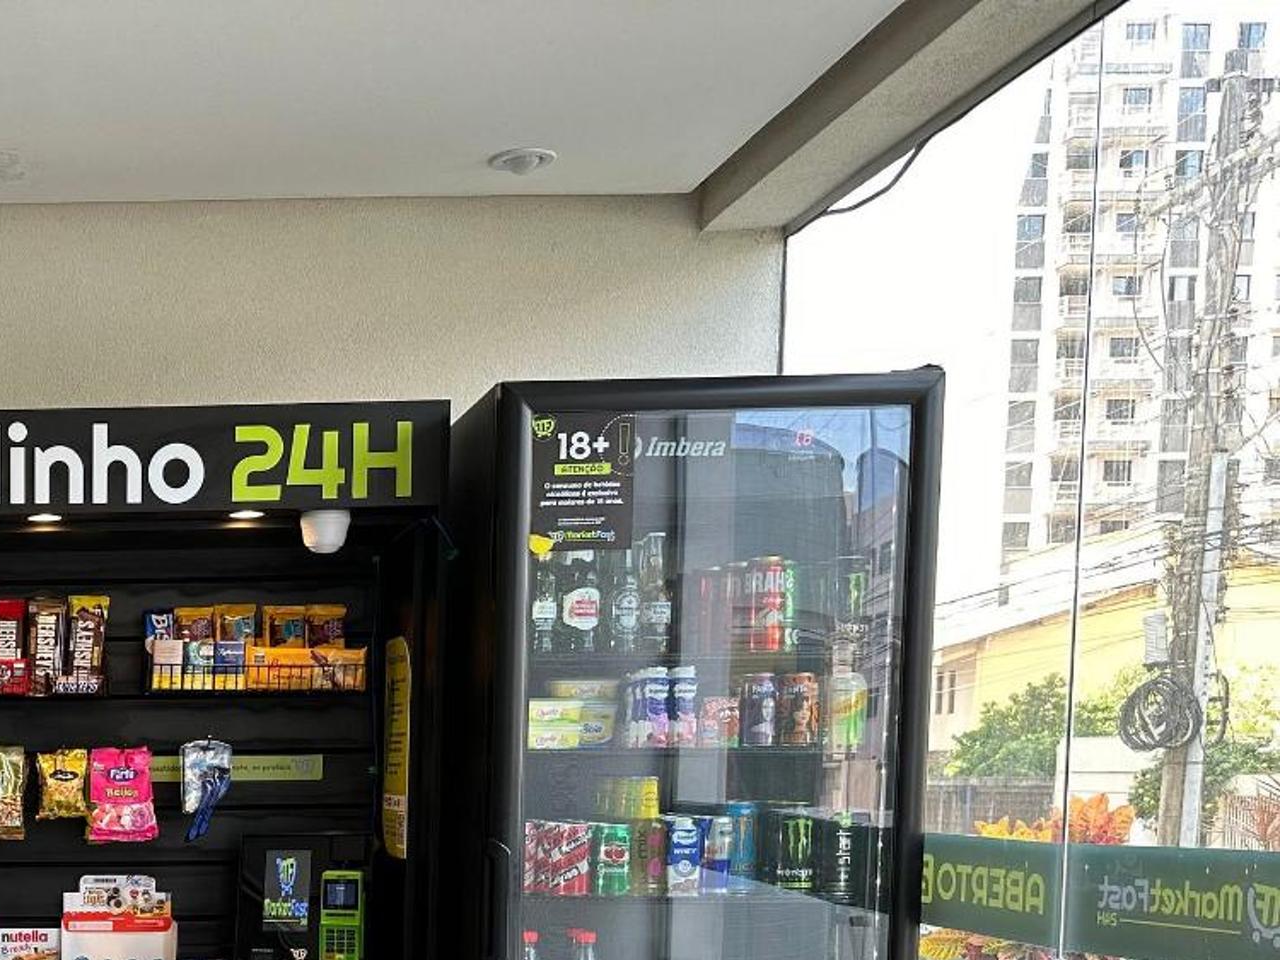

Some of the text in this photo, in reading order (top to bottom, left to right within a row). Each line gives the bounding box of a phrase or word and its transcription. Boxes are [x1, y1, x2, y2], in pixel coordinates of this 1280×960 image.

[557, 431, 610, 460] 18+
[645, 437, 727, 458] Imbera
[231, 420, 414, 502] 24H
[561, 464, 604, 474] ATENÇÃO
[1, 930, 48, 943] nutella
